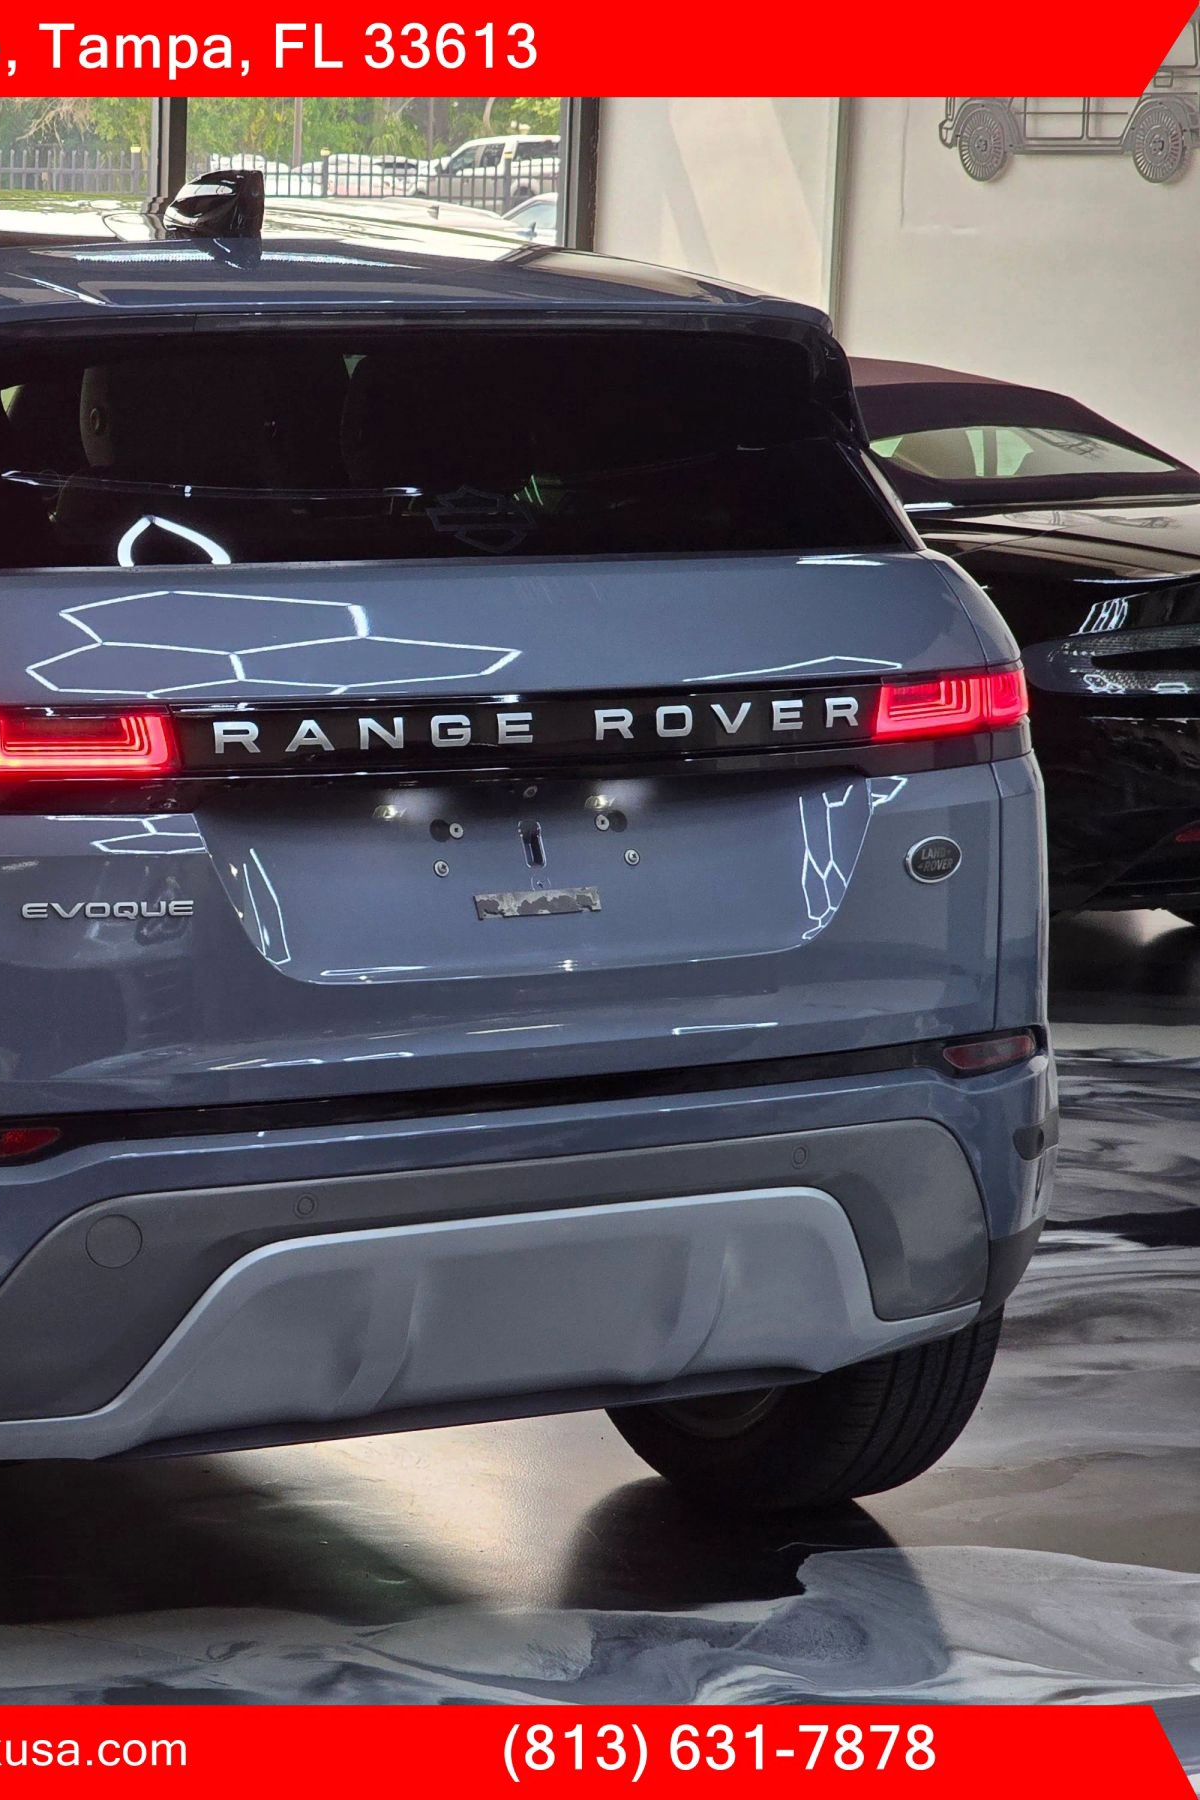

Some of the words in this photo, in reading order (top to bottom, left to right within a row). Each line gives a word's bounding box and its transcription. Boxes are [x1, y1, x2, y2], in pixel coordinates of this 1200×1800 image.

[212, 711, 534, 753] RANGE
[594, 696, 859, 740] ROVER
[920, 847, 947, 860] LAND
[923, 857, 954, 872] ROVER
[22, 900, 194, 920] EVOQUE
